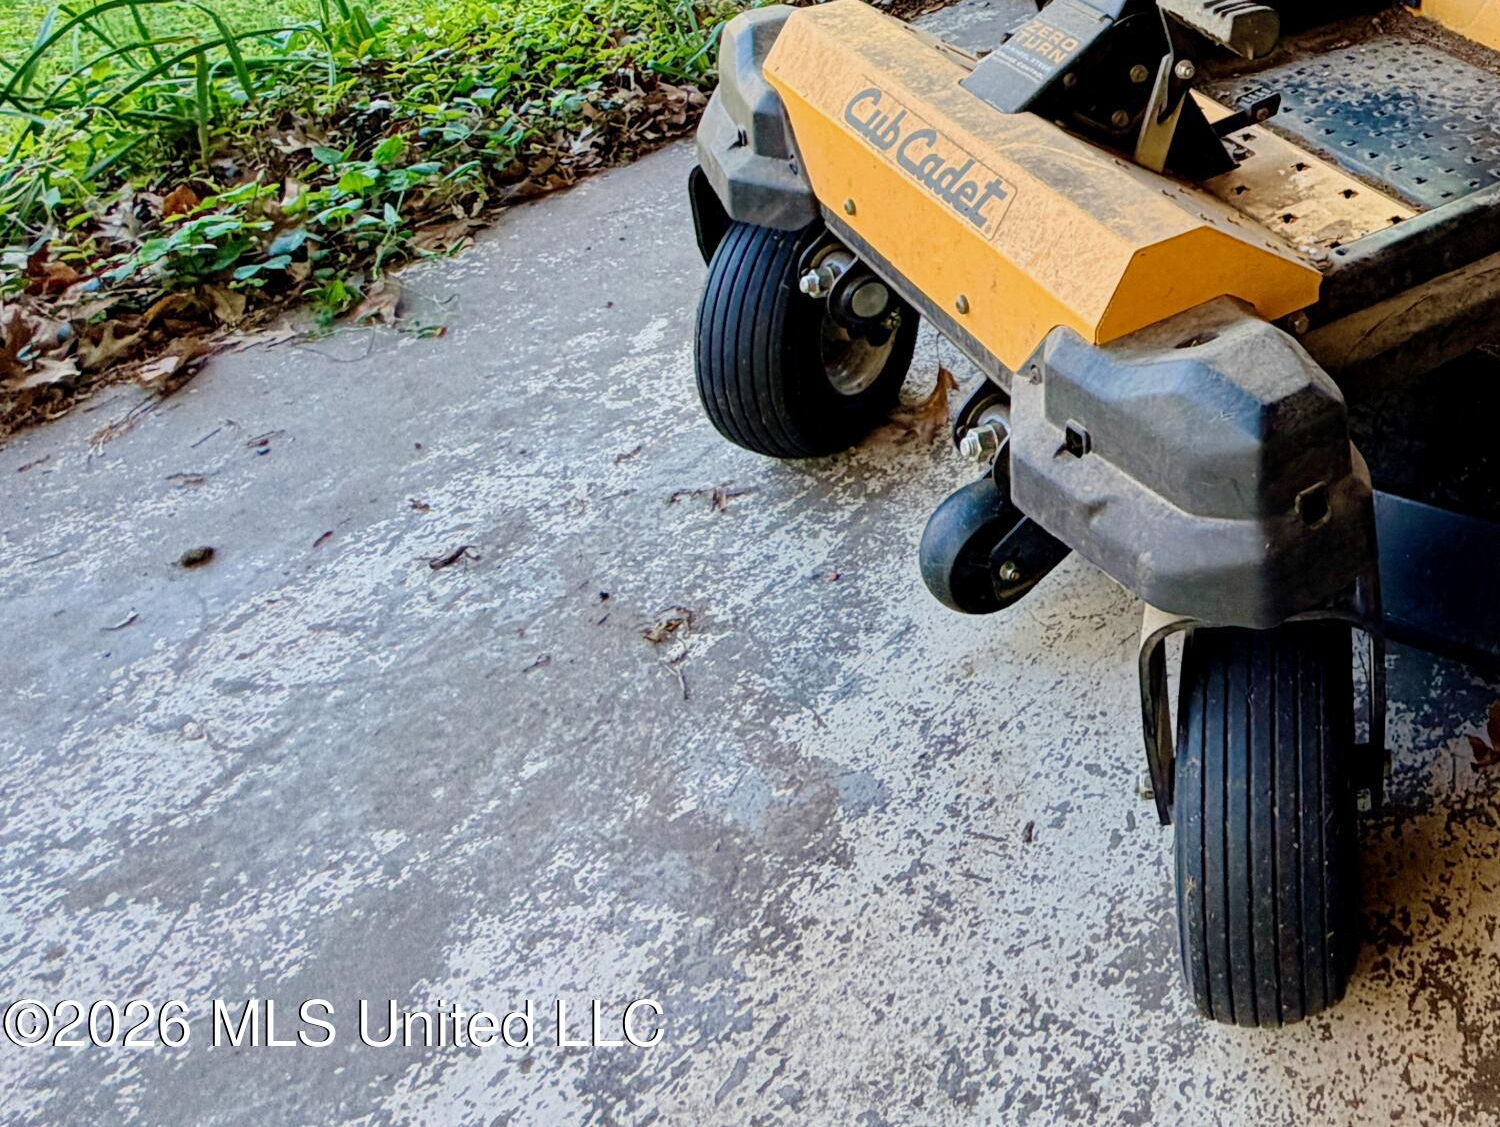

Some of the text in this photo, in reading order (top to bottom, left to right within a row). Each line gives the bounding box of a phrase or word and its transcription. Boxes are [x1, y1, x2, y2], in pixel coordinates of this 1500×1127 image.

[1016, 29, 1068, 65] TURN
[1026, 19, 1079, 53] ZERO
[845, 88, 1008, 227] Cub Cadet
